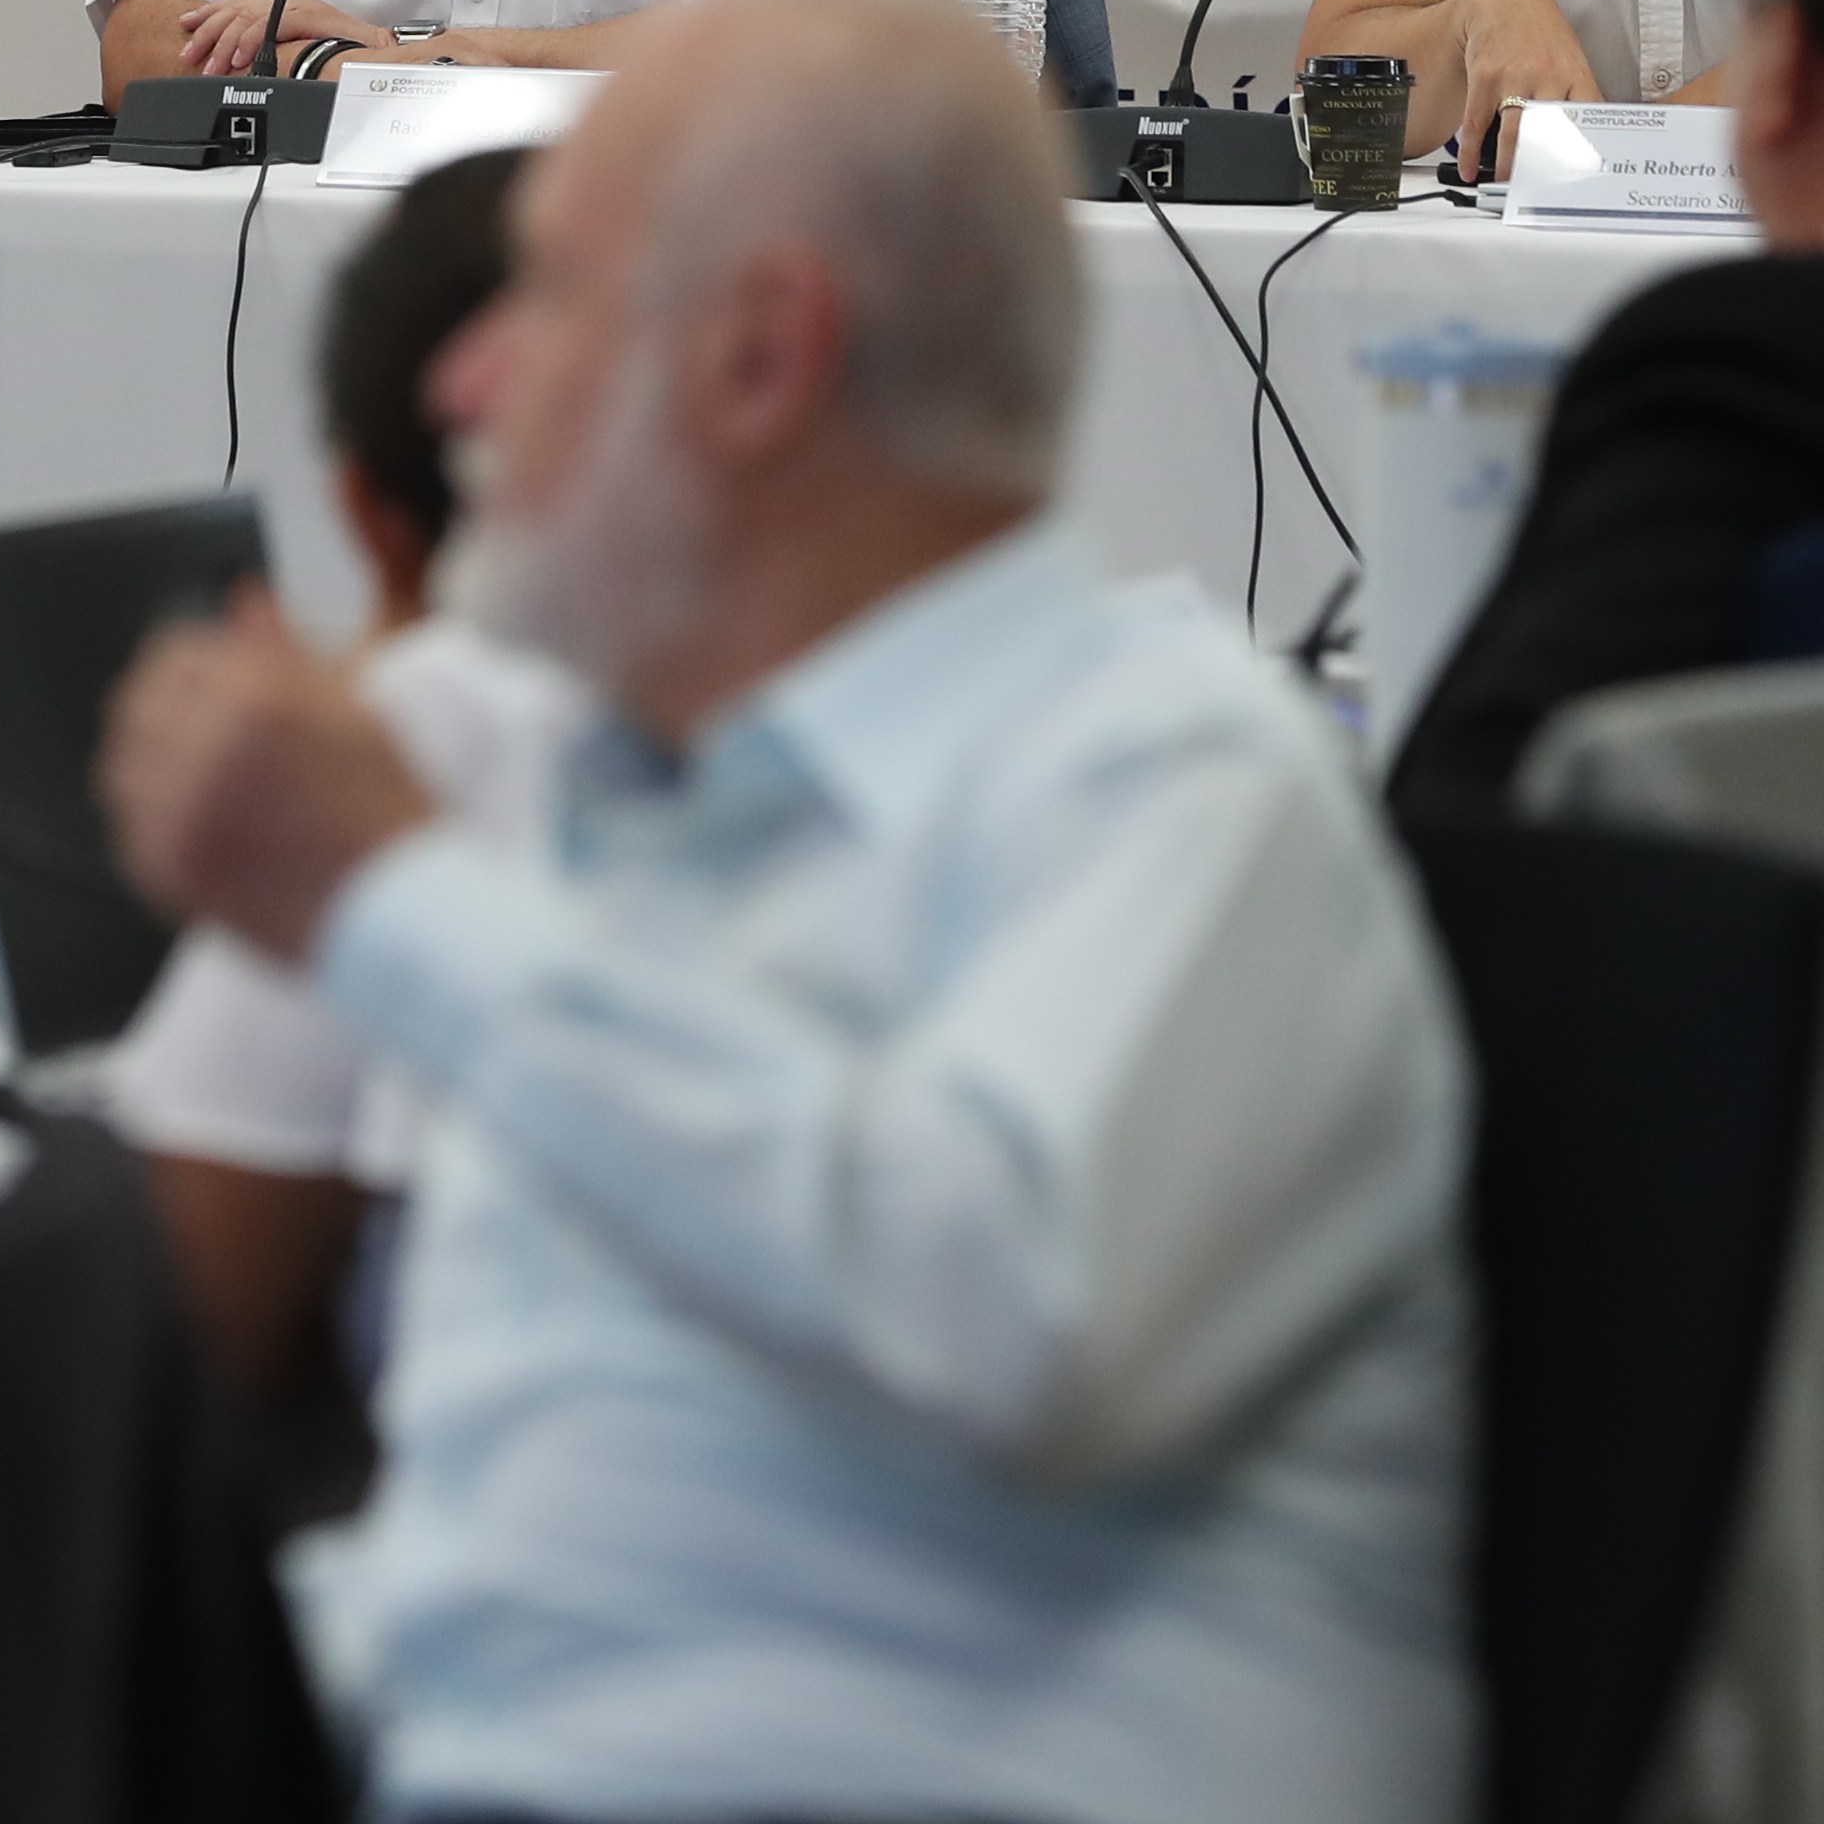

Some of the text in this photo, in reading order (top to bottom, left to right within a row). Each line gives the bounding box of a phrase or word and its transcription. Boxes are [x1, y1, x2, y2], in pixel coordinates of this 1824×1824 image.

[392, 78, 457, 88] COMISIONES
[1341, 87, 1408, 97] CAPPUCCIN
[1323, 101, 1384, 109] CHOCOLATE
[1583, 108, 1667, 118] COMISIONES DE
[1581, 116, 1666, 128] POSTULACIÓN
[1321, 148, 1385, 163] COFFEE
[1643, 158, 1716, 178] Roberto
[1626, 190, 1711, 209] Secretario
